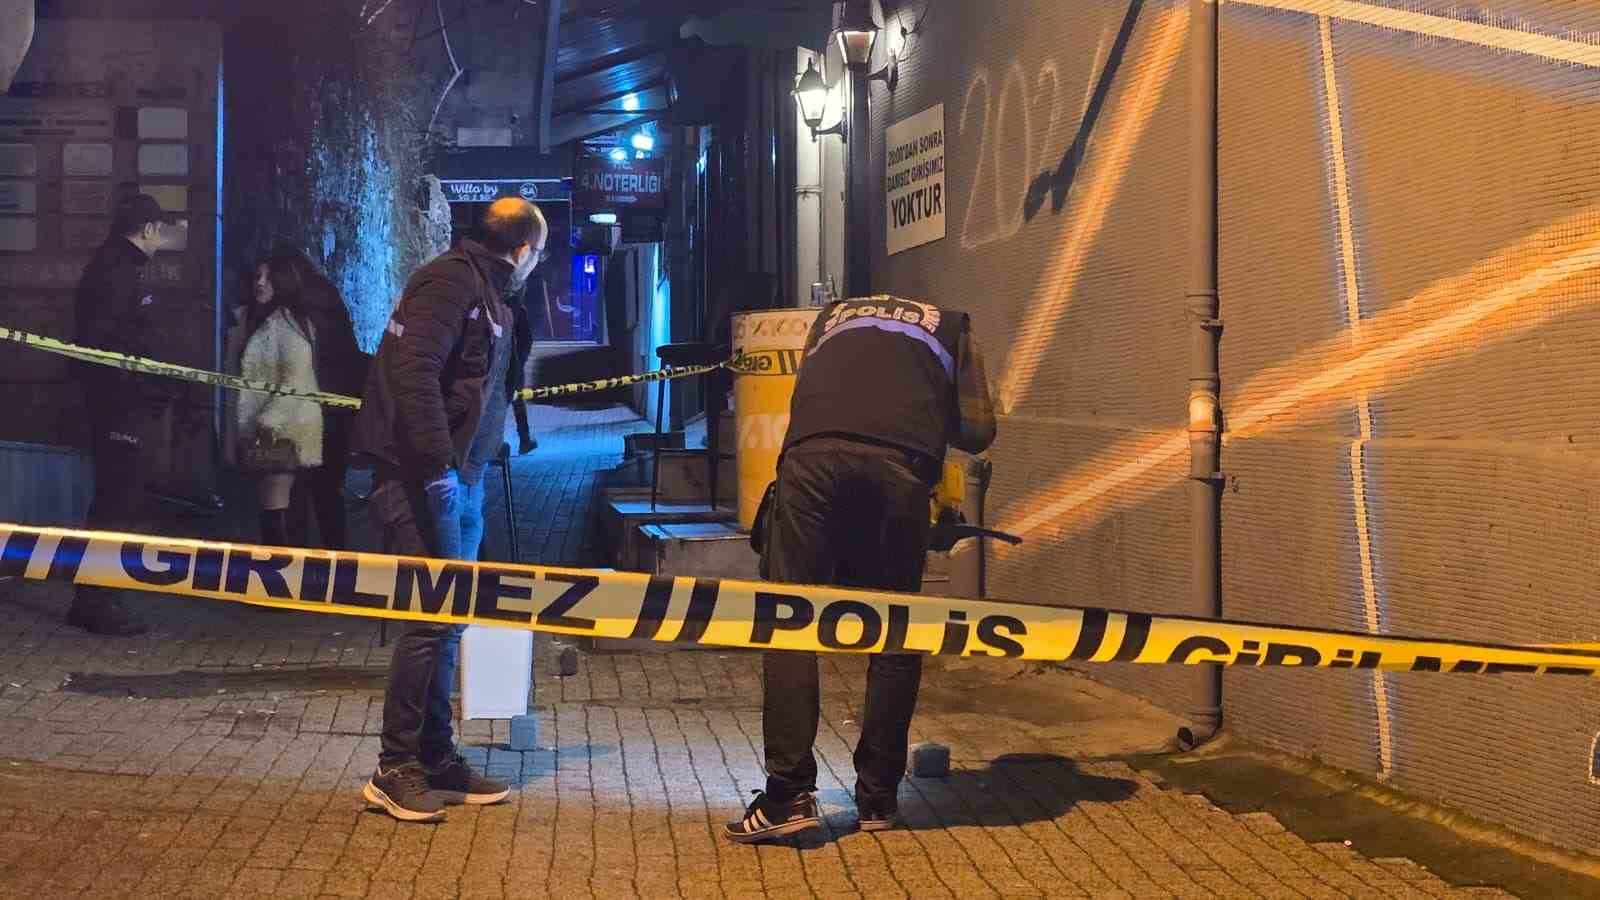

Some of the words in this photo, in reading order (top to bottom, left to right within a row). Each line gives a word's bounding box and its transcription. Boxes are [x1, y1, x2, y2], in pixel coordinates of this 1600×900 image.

[919, 130, 943, 154] SONRA
[483, 183, 498, 196] by
[891, 183, 942, 229] YOKTUR
[749, 592, 1028, 658] POLİS
